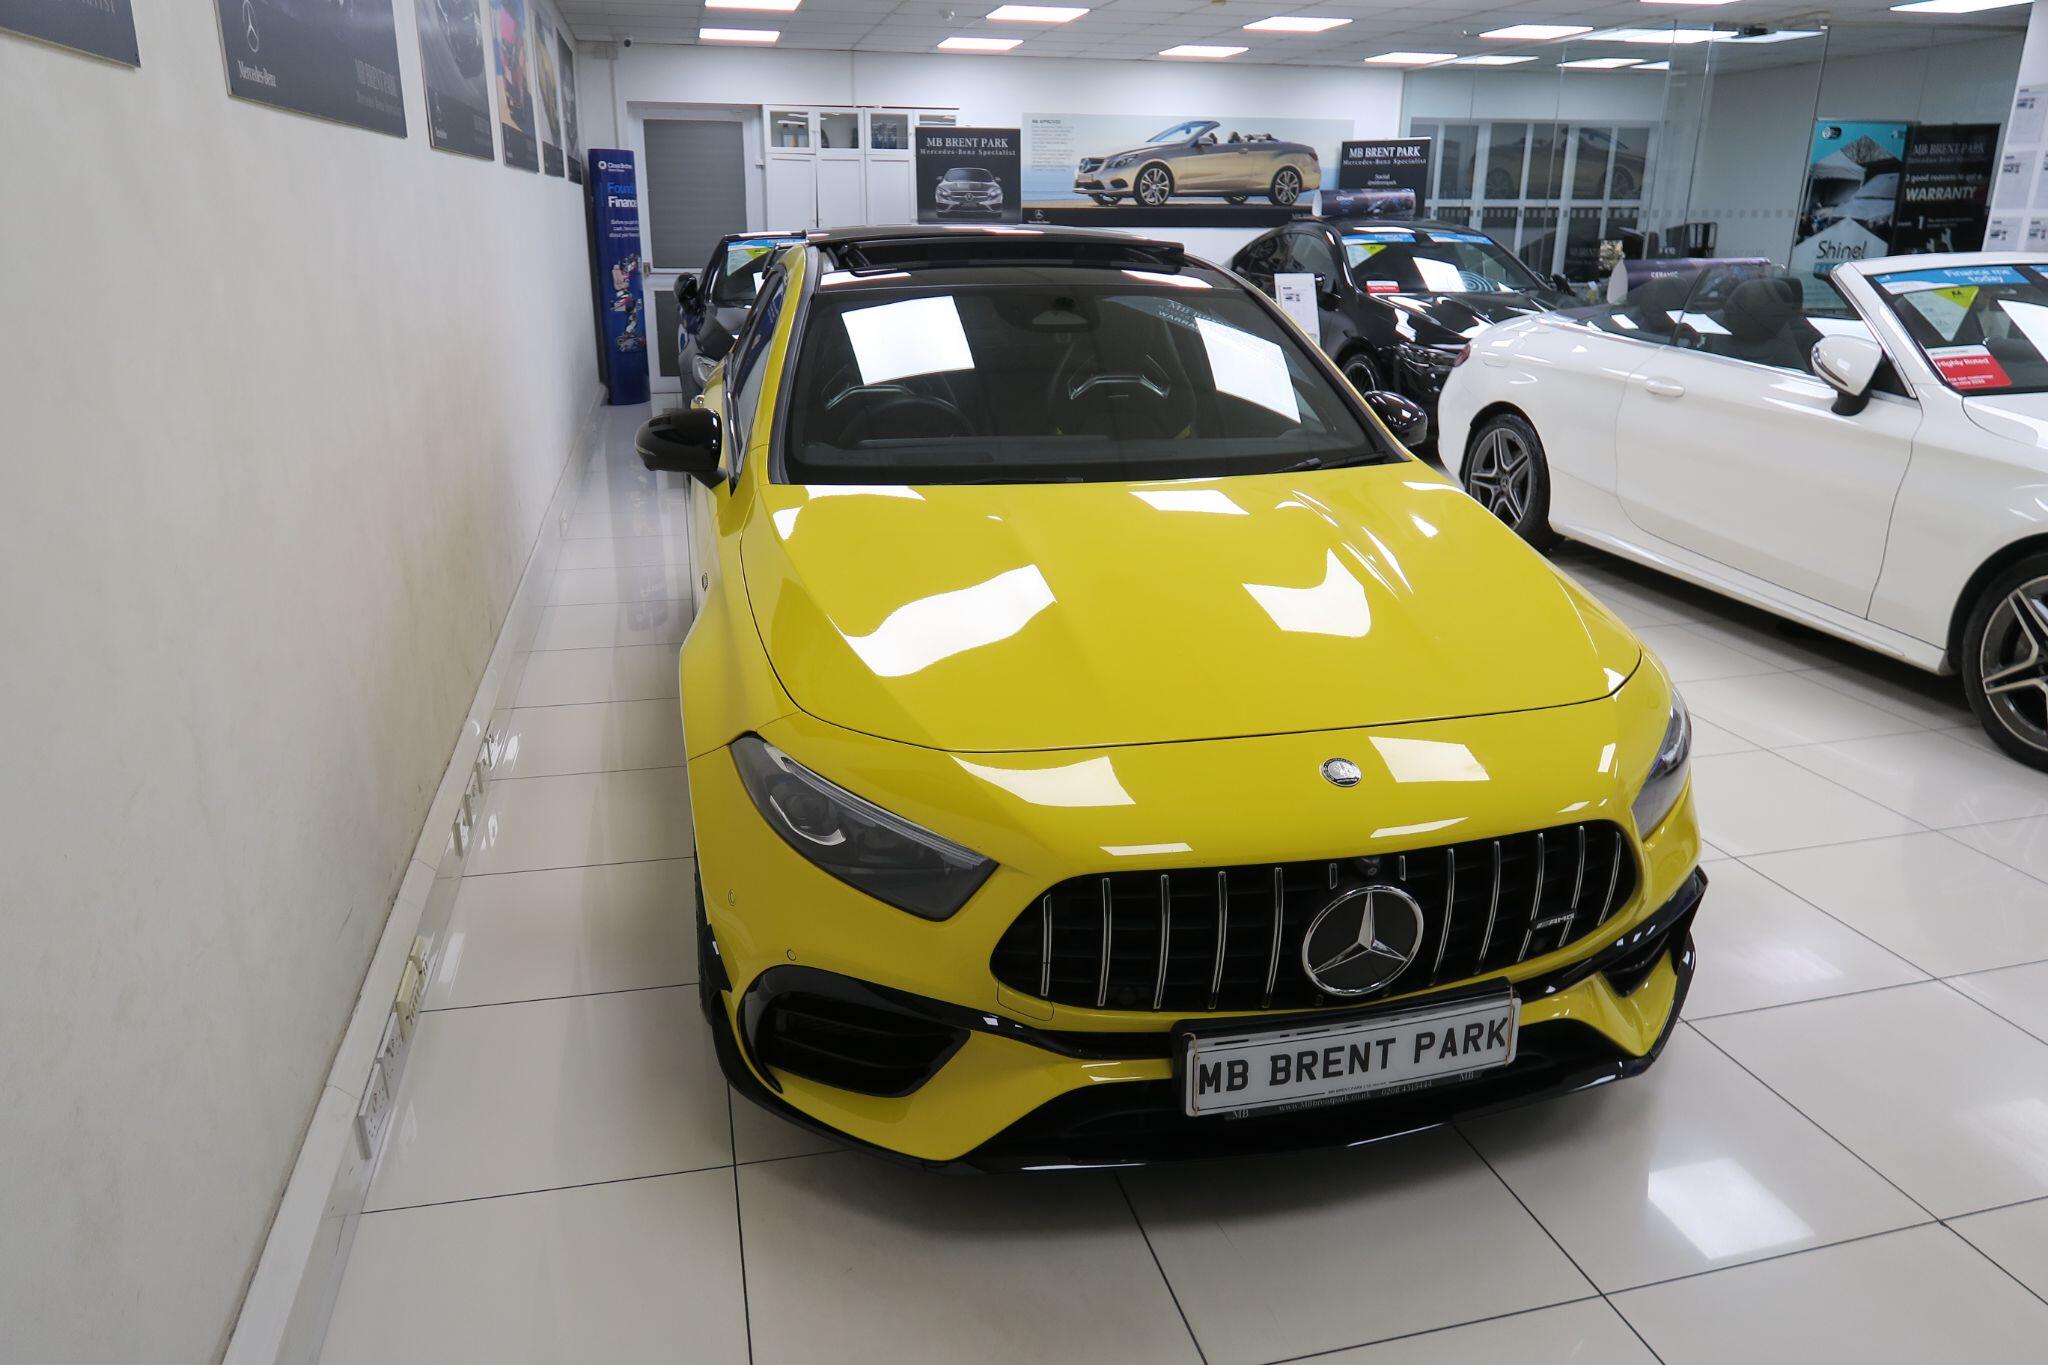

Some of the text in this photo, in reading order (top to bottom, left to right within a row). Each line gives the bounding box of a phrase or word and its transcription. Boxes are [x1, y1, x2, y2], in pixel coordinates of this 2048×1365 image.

[926, 137, 1009, 148] MB BRENT PARK
[1349, 145, 1421, 158] MB BRENT PARK
[1929, 143, 1960, 155] BRENT
[1906, 186, 1978, 202] WARRANTY
[1944, 269, 1991, 278] Finance
[1968, 275, 2004, 284] today
[1549, 913, 1576, 927] AMG
[1199, 1016, 1509, 1095] MB BRENT PARK
[1458, 1071, 1475, 1082] MB
[1232, 1108, 1249, 1120] MB
